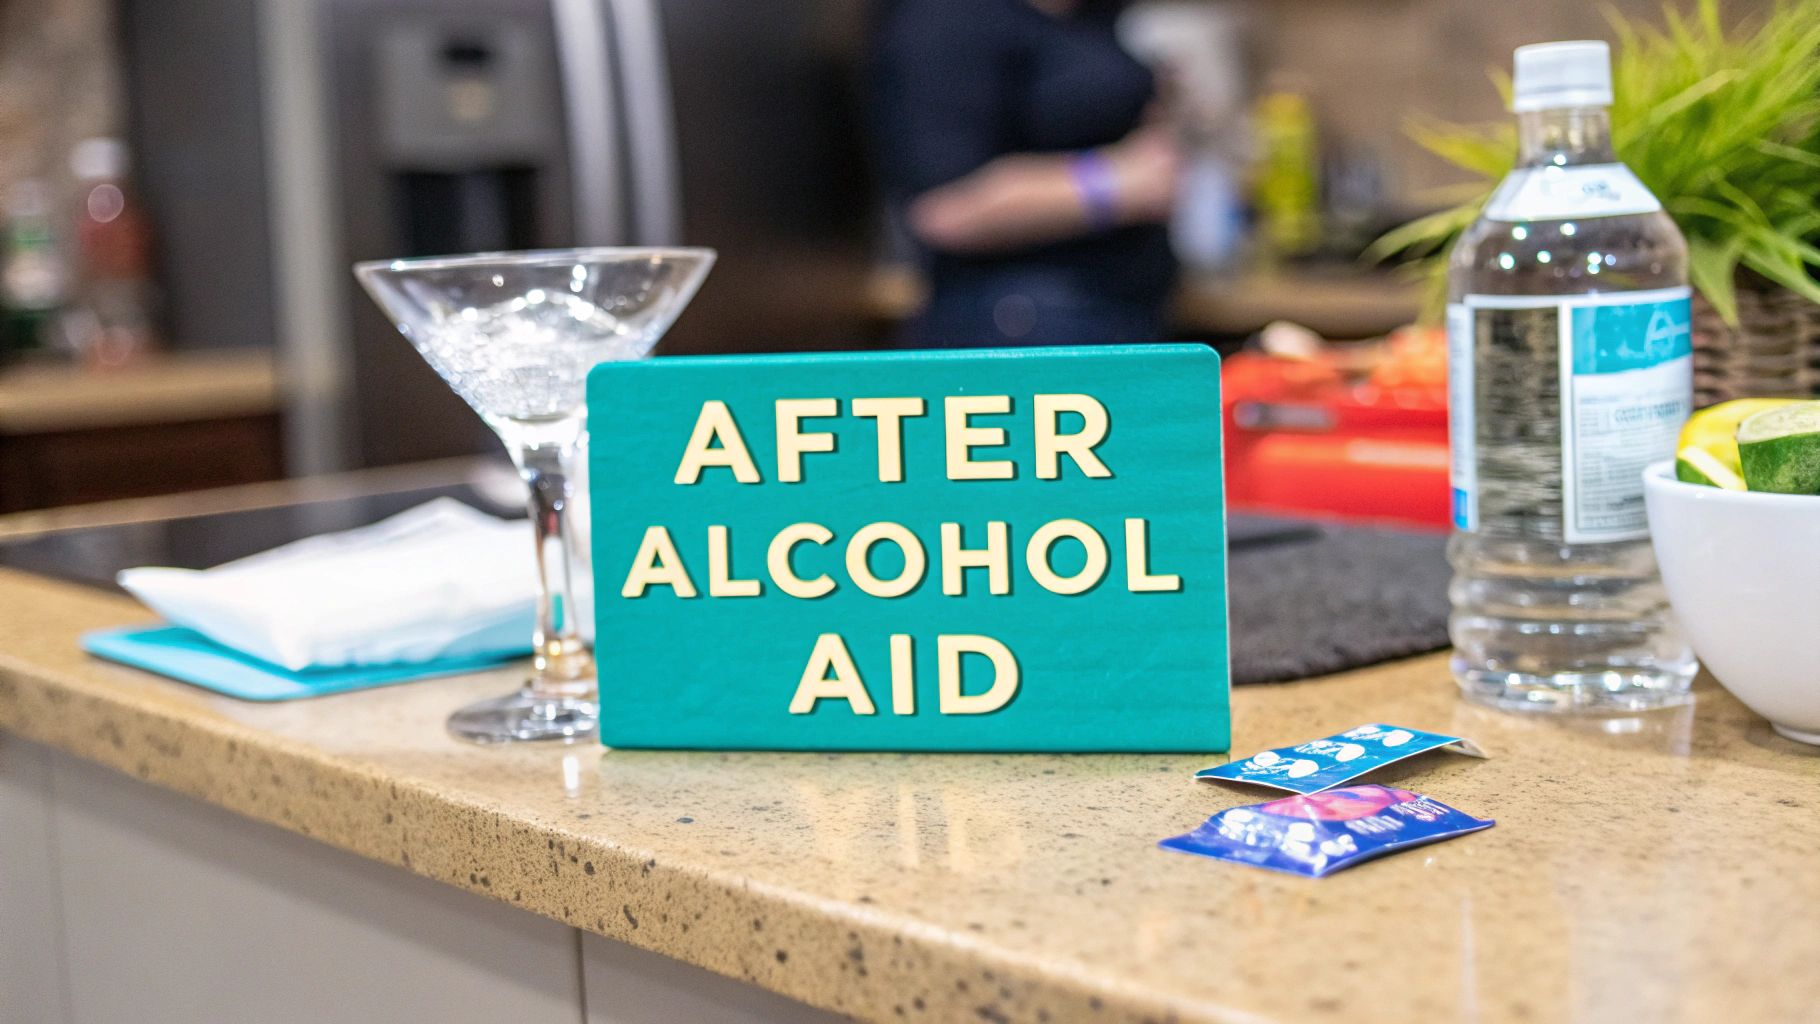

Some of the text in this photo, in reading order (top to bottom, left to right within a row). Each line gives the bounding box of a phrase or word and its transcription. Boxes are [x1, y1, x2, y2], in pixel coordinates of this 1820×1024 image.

[674, 393, 1112, 484] AFTER
[622, 518, 1180, 598] ALCOHOL
[788, 633, 1020, 716] AID
